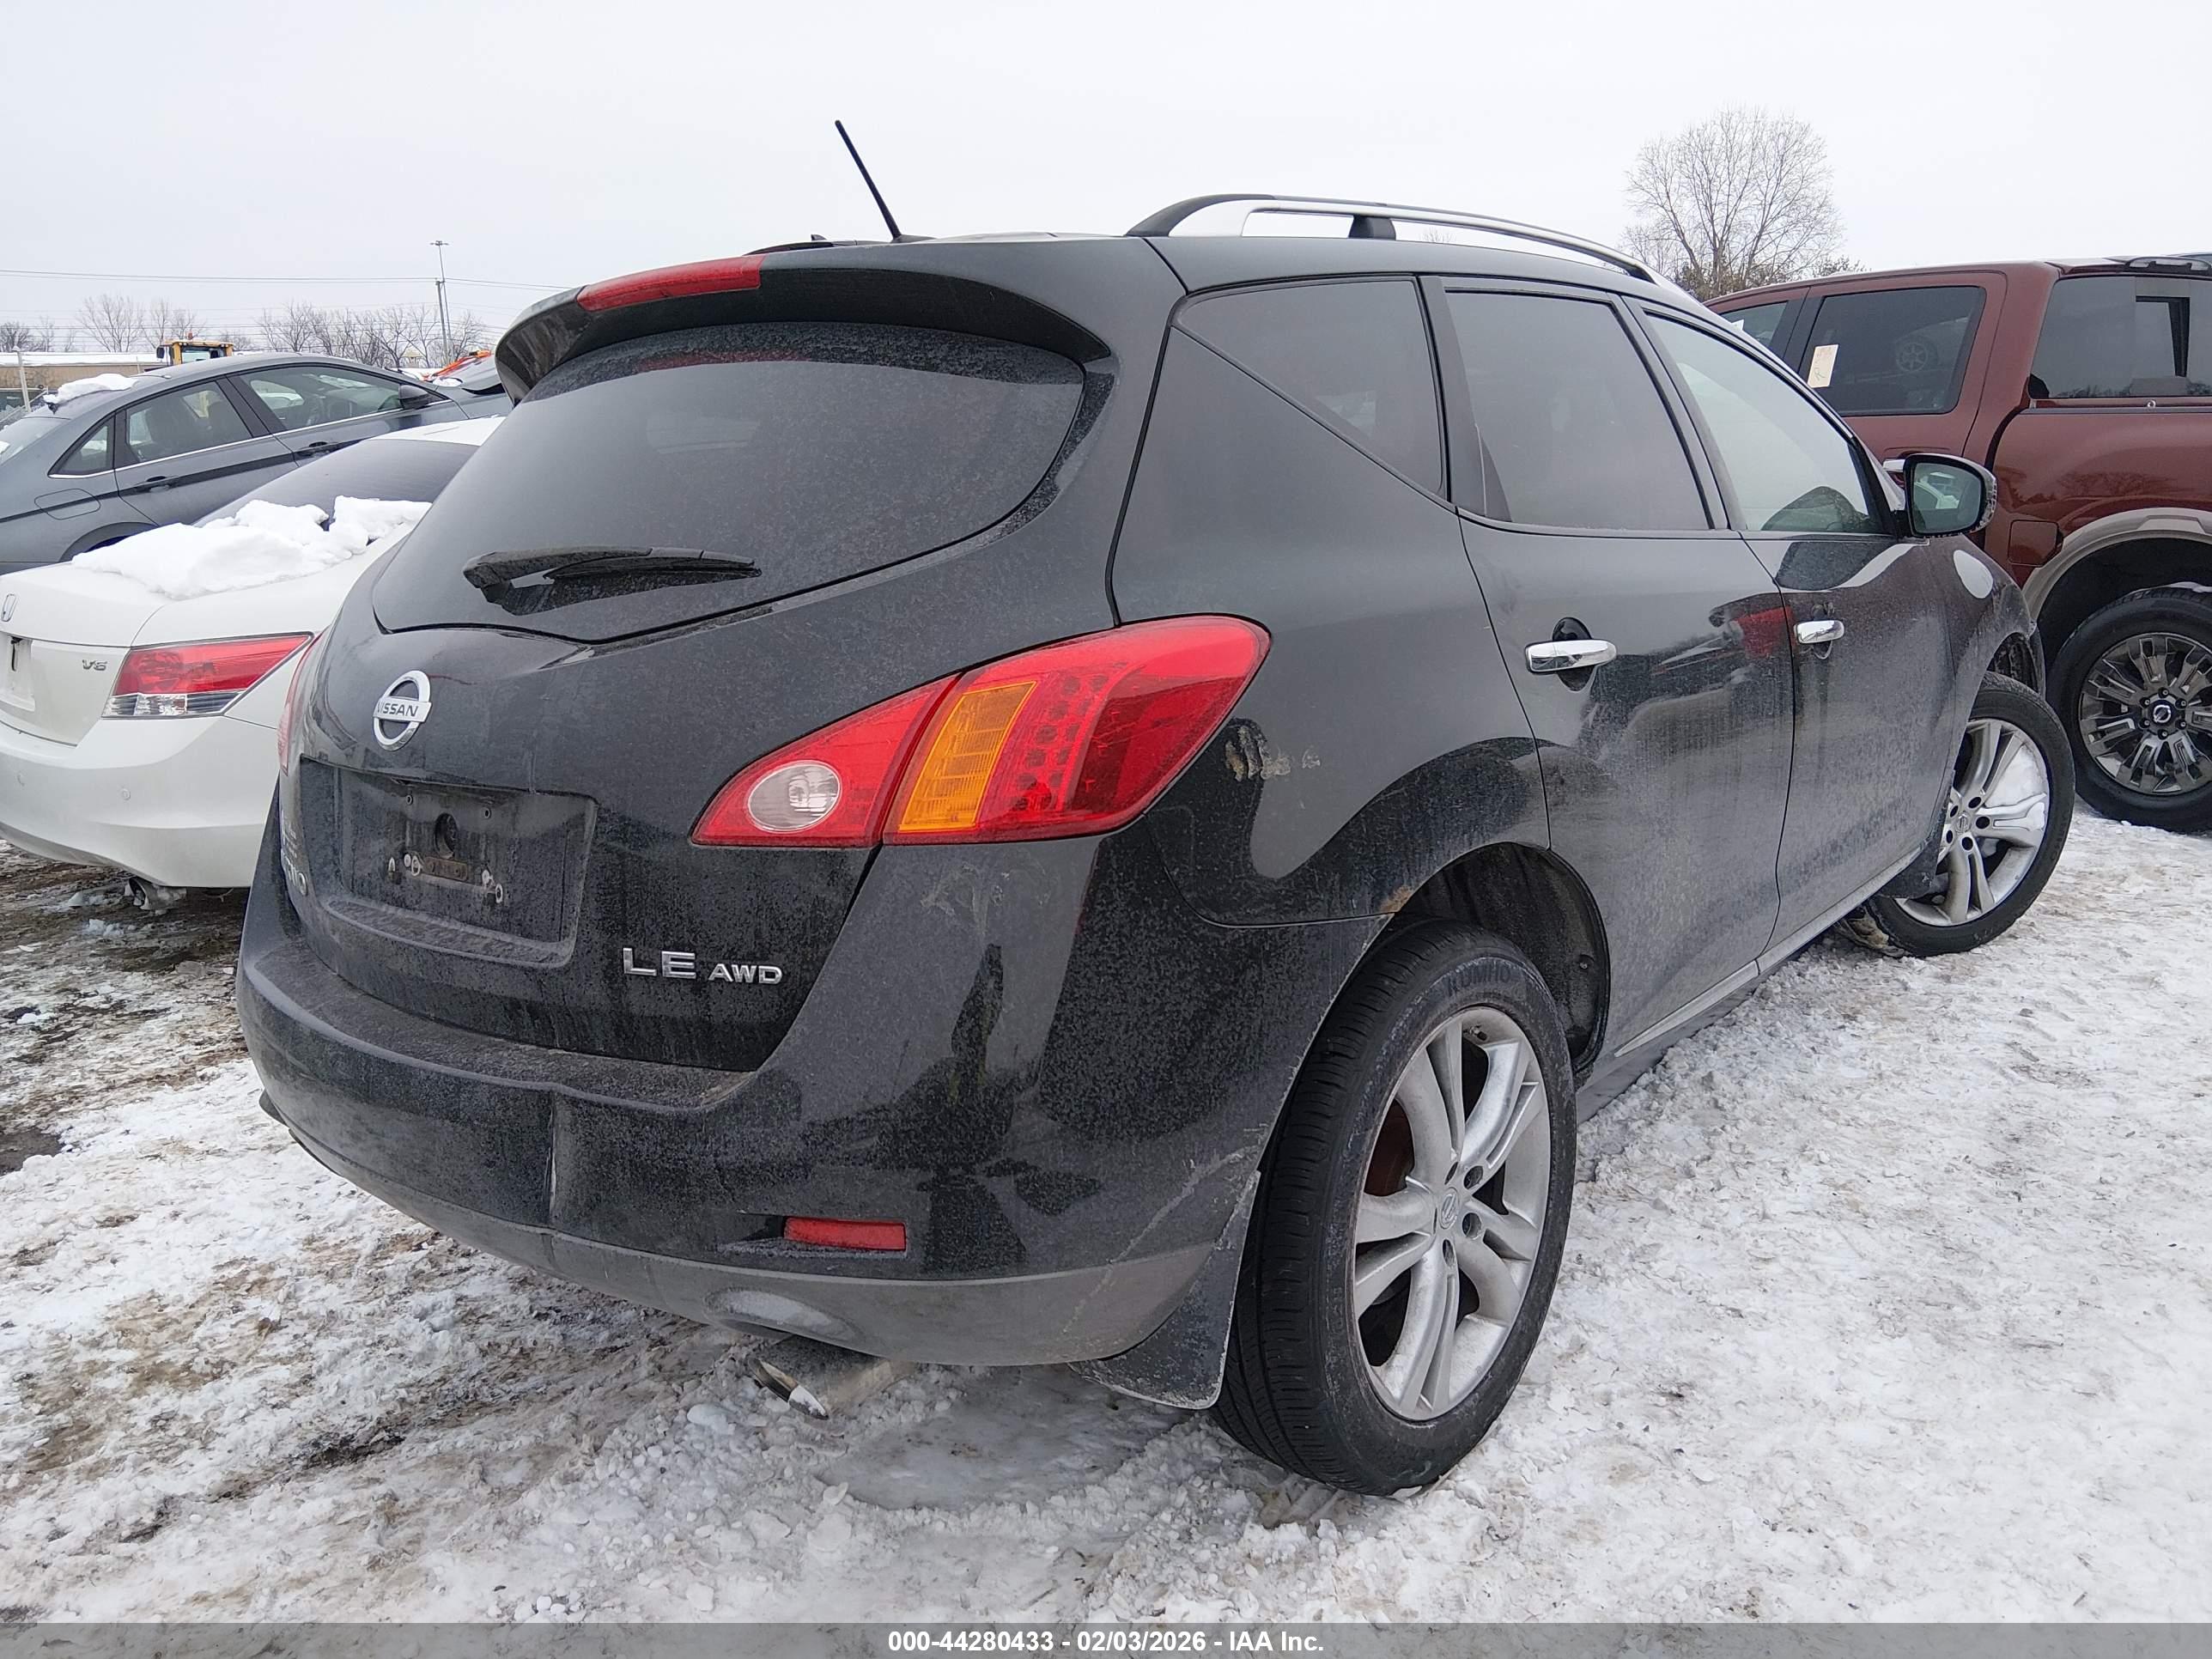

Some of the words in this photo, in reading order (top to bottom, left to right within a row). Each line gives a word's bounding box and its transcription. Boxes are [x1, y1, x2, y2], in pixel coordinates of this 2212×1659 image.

[82, 659, 108, 672] V6
[377, 702, 419, 717] NISSAN
[623, 947, 696, 979] LE
[708, 963, 783, 985] AWD
